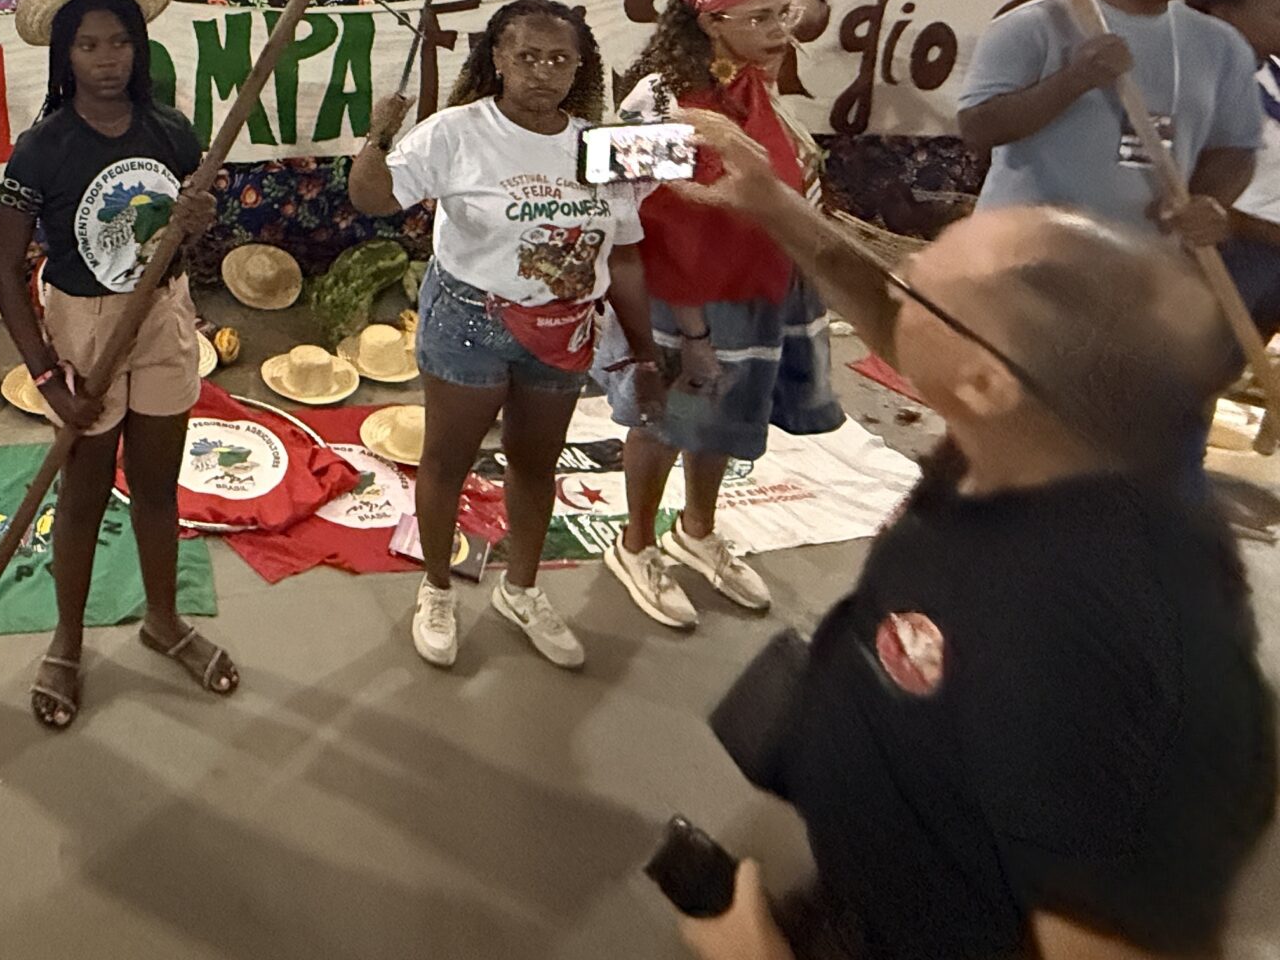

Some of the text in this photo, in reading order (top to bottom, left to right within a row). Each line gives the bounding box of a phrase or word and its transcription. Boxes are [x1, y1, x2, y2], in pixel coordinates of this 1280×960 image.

[192, 10, 376, 152] MPA
[102, 160, 160, 185] PEQUENOS
[86, 181, 105, 206] DOS
[524, 185, 563, 201] FEIRA
[505, 199, 612, 223] CAMPONESA
[76, 206, 101, 269] MOVIMENTO
